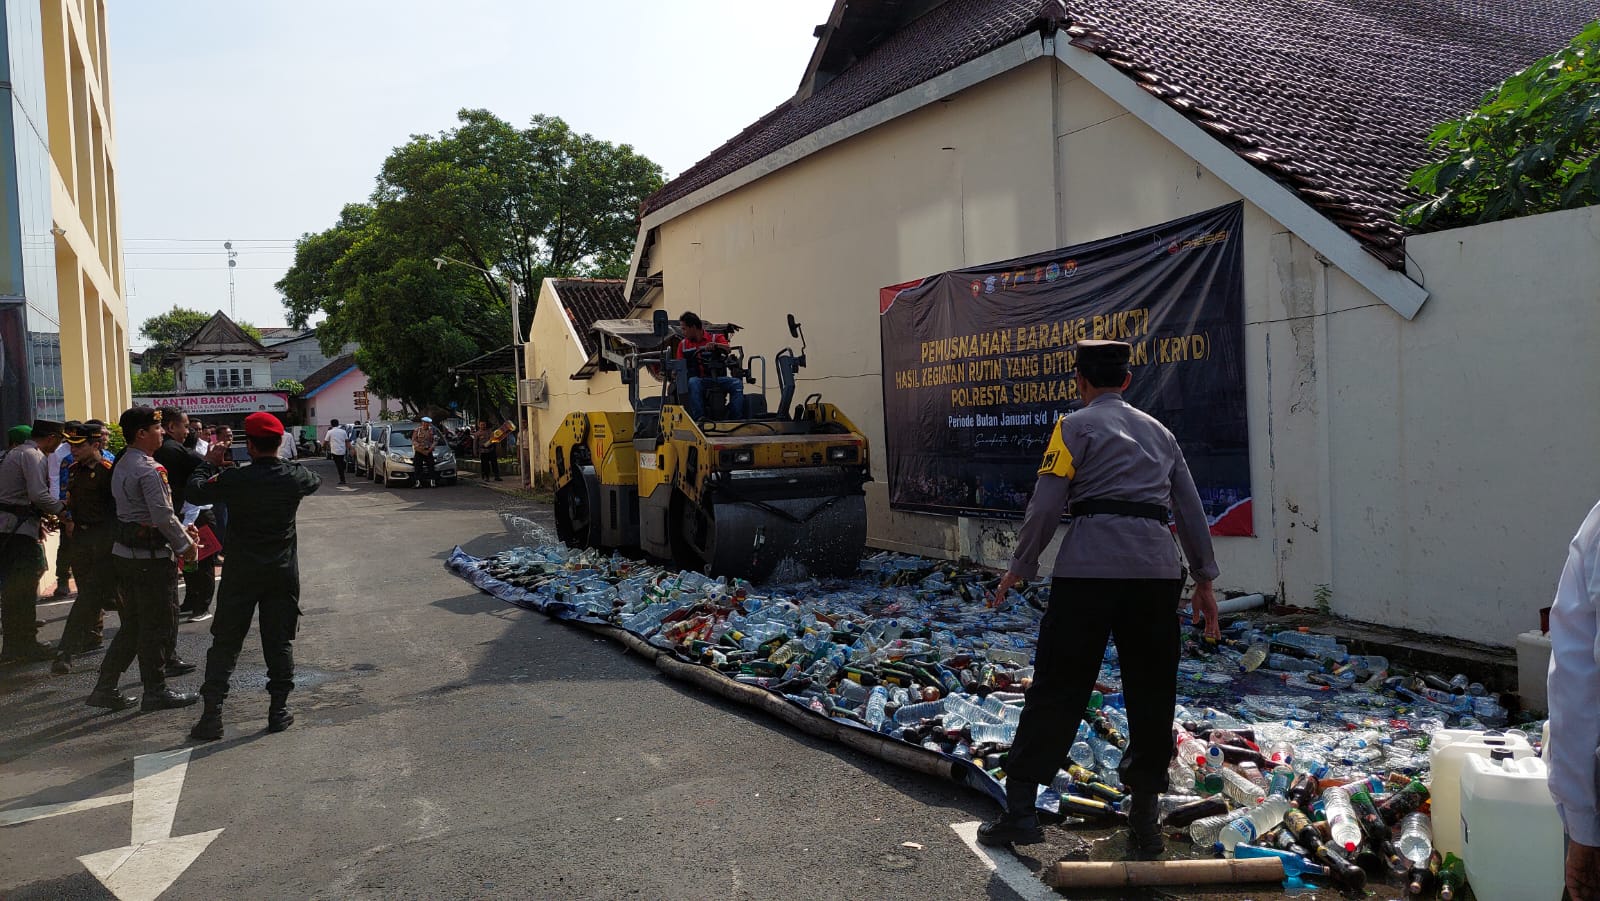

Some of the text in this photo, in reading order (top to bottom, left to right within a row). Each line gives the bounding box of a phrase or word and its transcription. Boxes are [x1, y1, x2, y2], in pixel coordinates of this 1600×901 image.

[920, 308, 1149, 364] PEMUSNAHAN BARANG BUKTI
[895, 331, 1211, 390] HASIL KEGIATAN RUTIN YANG DITINAN (KRYD)
[153, 395, 257, 406] KANTIN BAROKAH
[951, 380, 1081, 408] POLRESTA SURAKAR
[948, 415, 975, 428] Periode
[976, 413, 998, 427] Bulan
[1000, 412, 1033, 426] Januari
[1034, 410, 1048, 426] s/d
